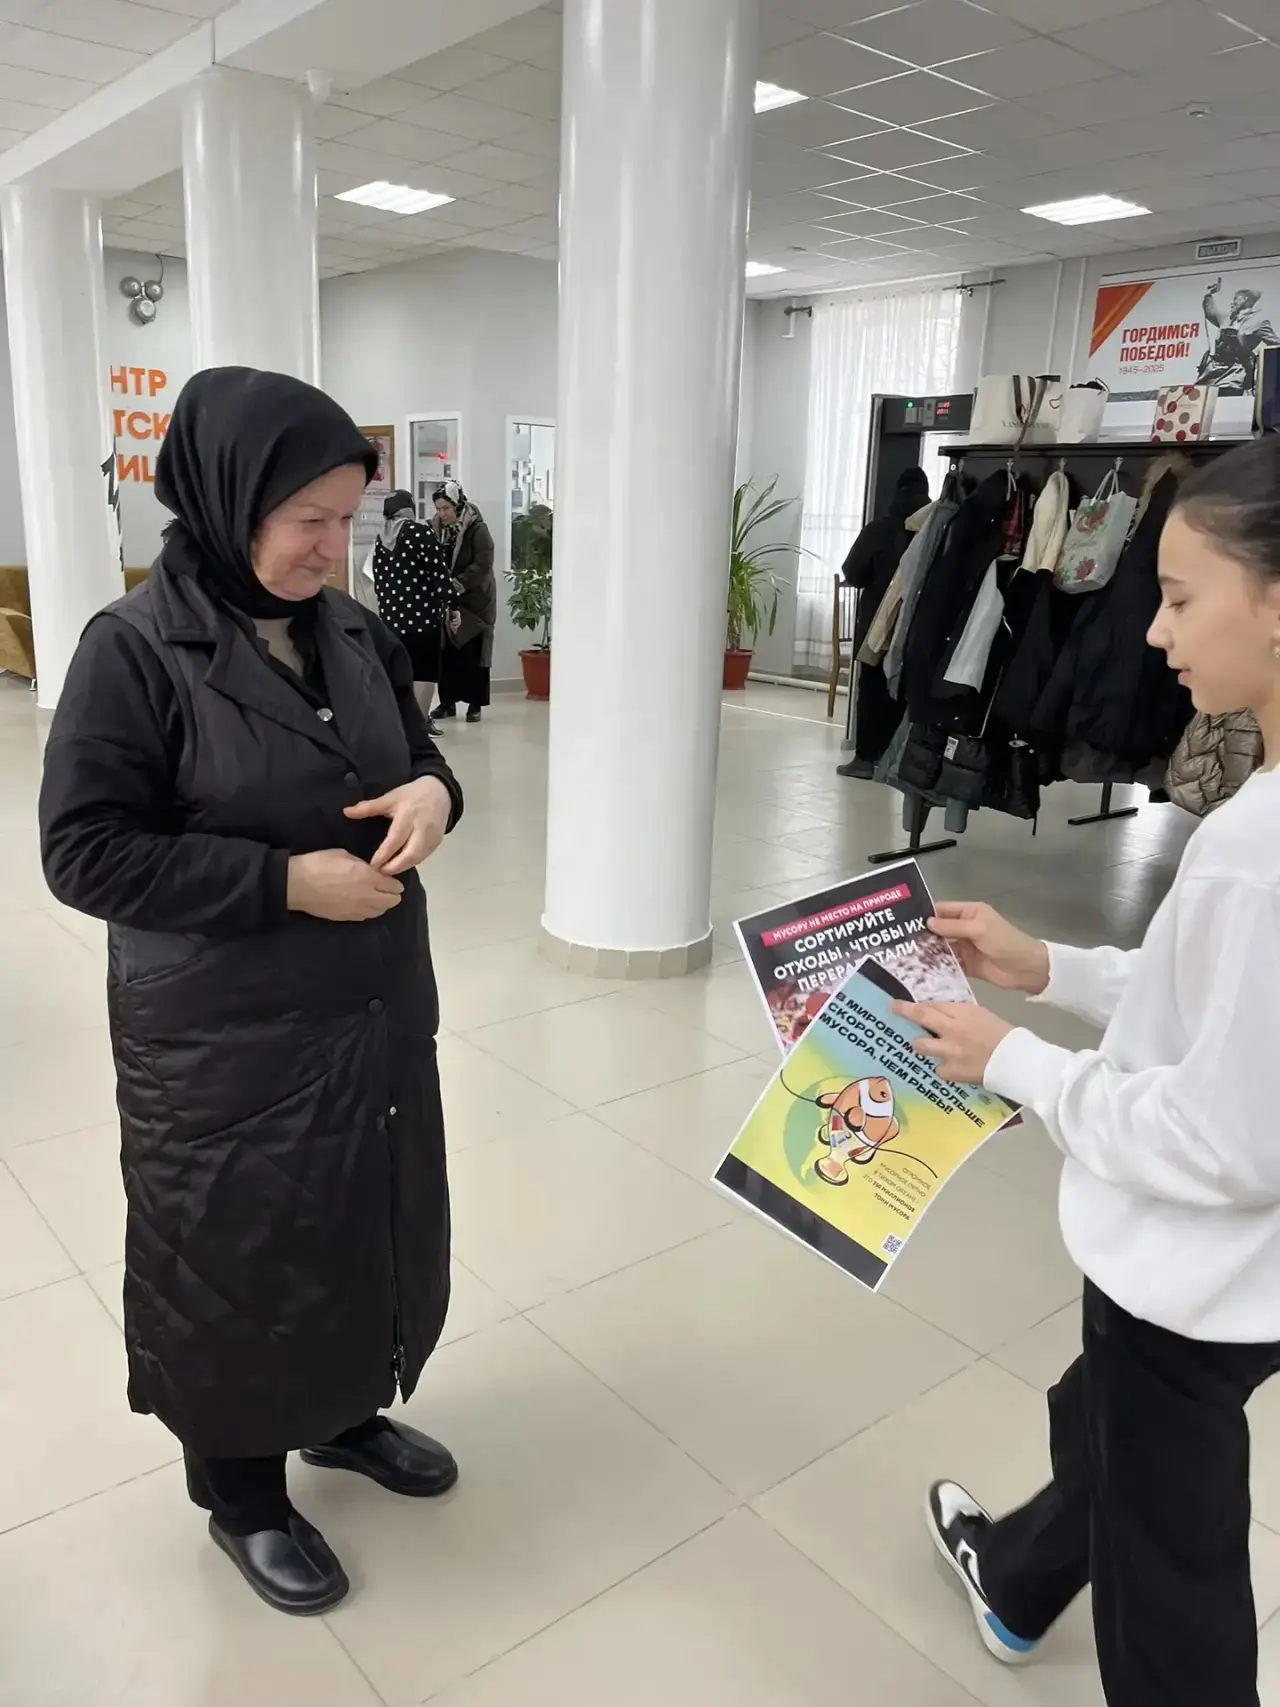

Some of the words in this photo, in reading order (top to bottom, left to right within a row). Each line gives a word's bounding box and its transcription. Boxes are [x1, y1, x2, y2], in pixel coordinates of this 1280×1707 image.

[1120, 341, 1190, 362] ПОБЕДОЙ!
[1122, 323, 1200, 344] ГОРДИМСЯ
[773, 921, 809, 941] МУСОРУ
[809, 917, 820, 928] НЕ
[821, 908, 850, 924] МЕСТО
[850, 902, 864, 914] НА
[863, 889, 903, 908] ПРИРОДЕ
[794, 907, 896, 953] СОРТИРУЙТЕ
[849, 925, 904, 953] ЧТОБЫ
[904, 917, 927, 931] ИХ
[835, 991, 847, 1001] В
[846, 999, 914, 1054] МИРОВОМ
[819, 1012, 877, 1061] МУСОРА,
[879, 1054, 908, 1081] ЧЕМ
[907, 1078, 954, 1115] РЫБЫ!
[828, 1002, 875, 1039] СКОРО
[875, 1036, 933, 1080] СТАНЕТ
[930, 1079, 986, 1128] БОЛЬШЕ
[874, 1192, 889, 1206] ТОНН
[888, 1203, 910, 1221] МУСОРА
[881, 1186, 915, 1213] МИЛЛИОНОВ
